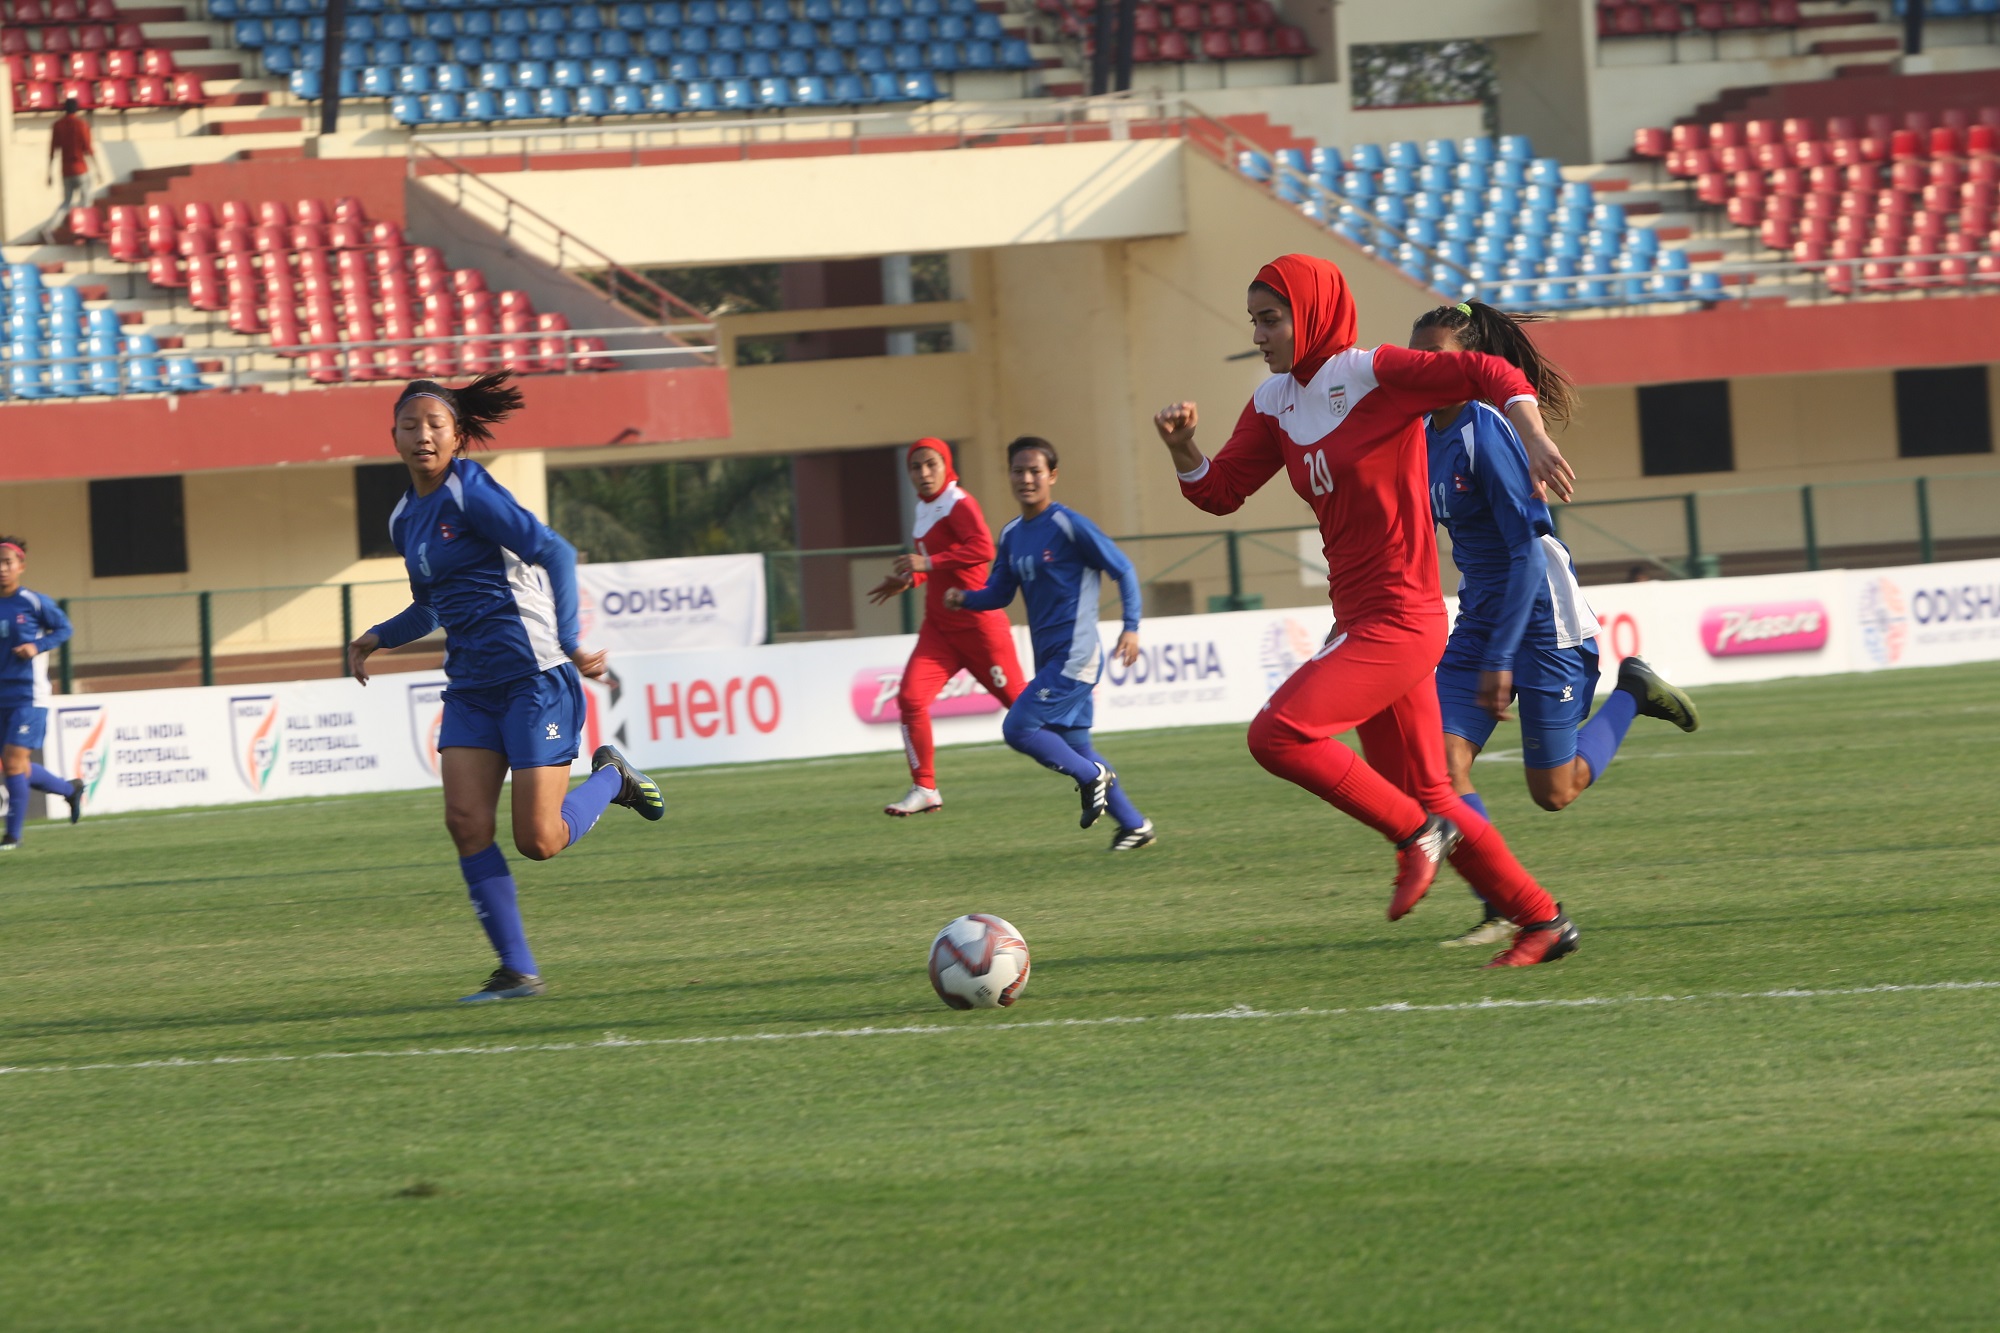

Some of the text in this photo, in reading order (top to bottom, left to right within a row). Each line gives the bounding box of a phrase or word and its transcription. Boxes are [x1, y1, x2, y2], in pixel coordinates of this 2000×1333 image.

[1303, 448, 1334, 496] 20
[1430, 482, 1451, 518] 12
[603, 585, 717, 616] ODISHA
[1911, 583, 2000, 625] ODISH
[1106, 641, 1225, 686] ODISHA
[989, 665, 1008, 688] 8
[645, 674, 781, 742] Hero
[115, 722, 185, 740] ALL INDIA
[285, 710, 355, 731] ALL INDIA
[115, 745, 191, 765] FOOTBALL
[287, 734, 361, 754] FOOTBALL
[288, 754, 379, 776] FEDERATION
[117, 767, 209, 787] FEDERATION
